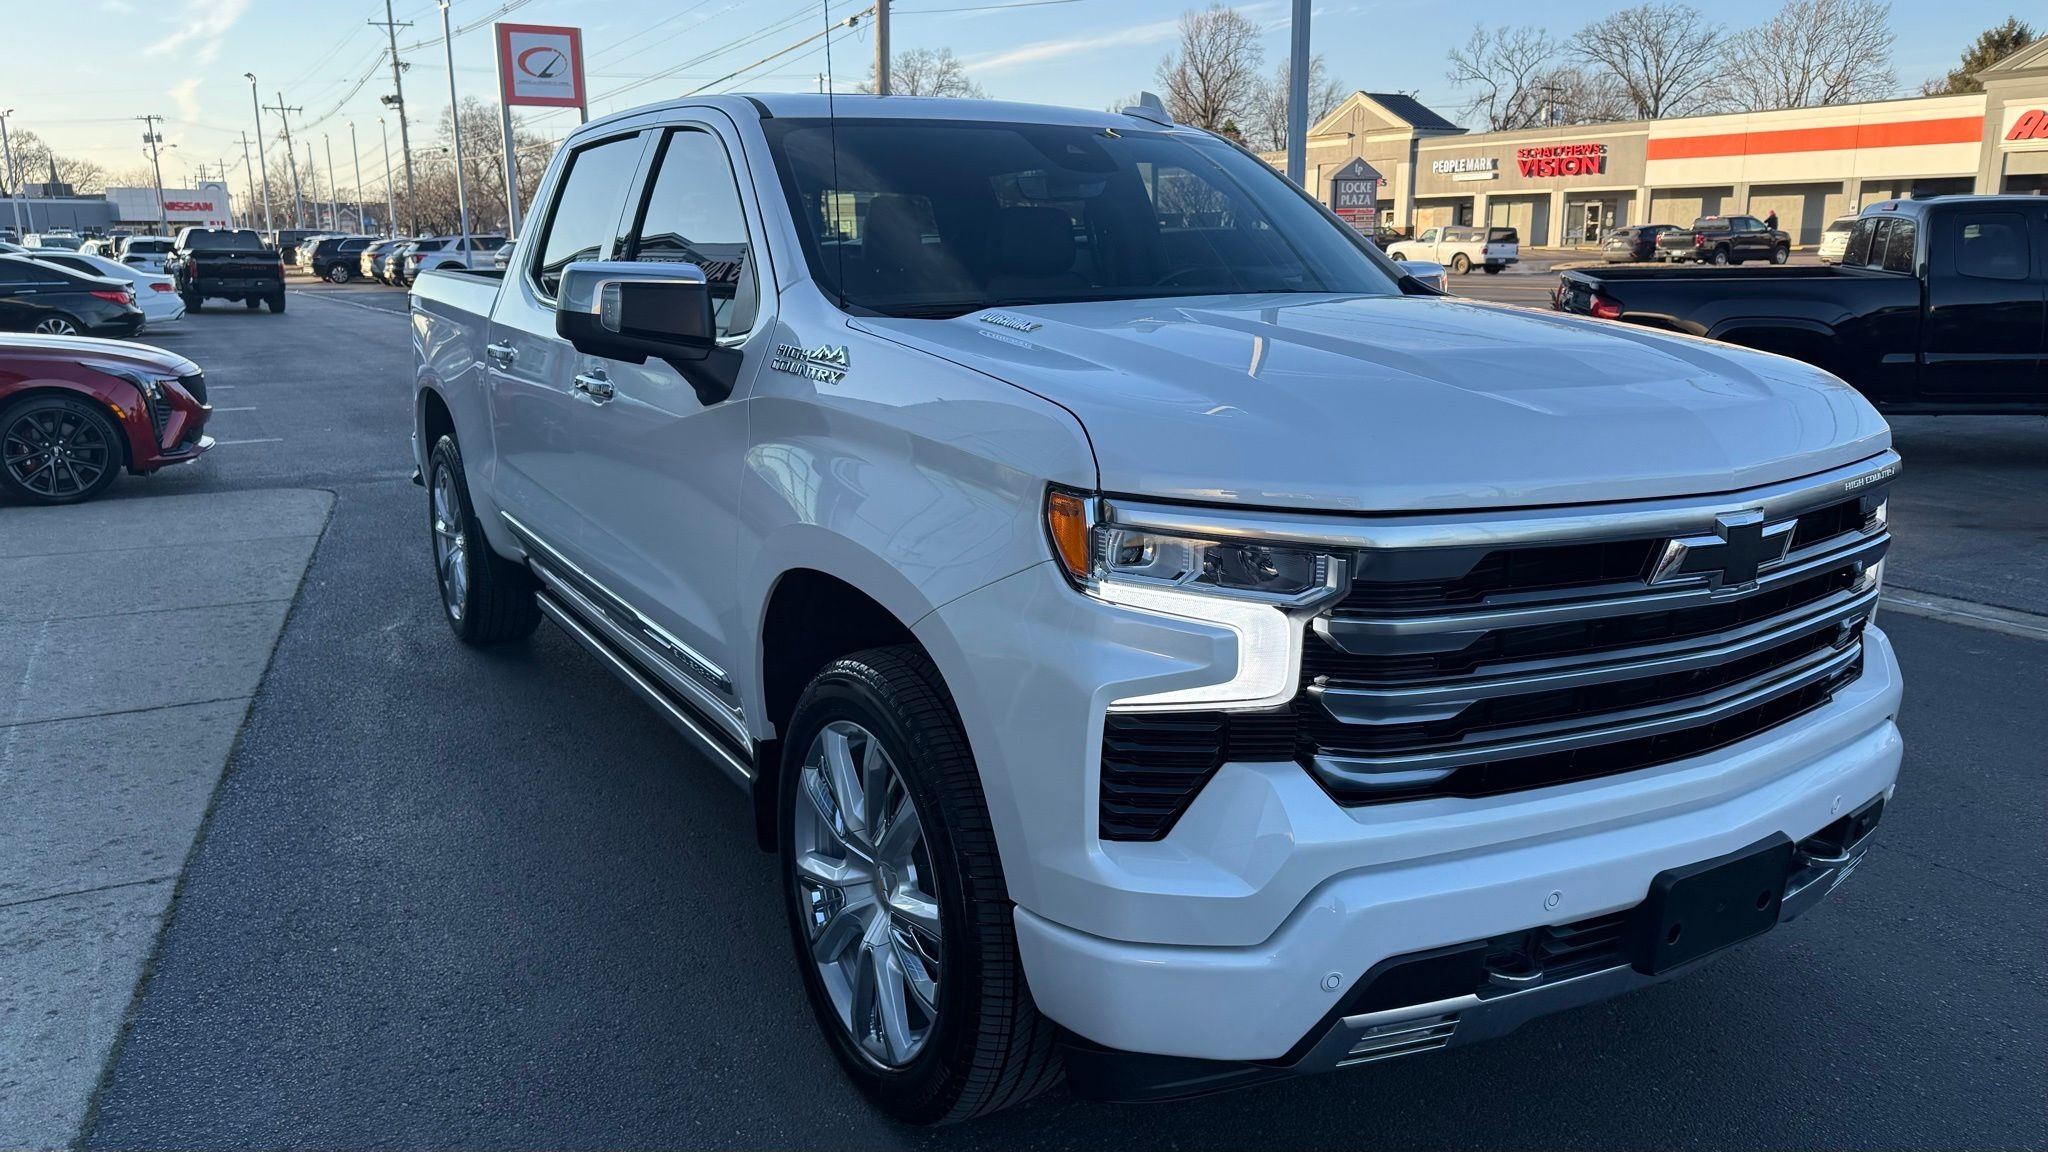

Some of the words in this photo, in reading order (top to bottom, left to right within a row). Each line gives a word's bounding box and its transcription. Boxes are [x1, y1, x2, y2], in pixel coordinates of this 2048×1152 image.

[1517, 155, 1601, 178] VISION
[1341, 182, 1372, 193] LOCKE
[164, 202, 213, 211] NISSAN
[1341, 194, 1371, 206] PLAZA
[776, 343, 810, 361] HIGH
[771, 358, 845, 386] COUNTRY
[1845, 477, 1864, 491] HIGH
[1865, 466, 1896, 484] COUNTRY
